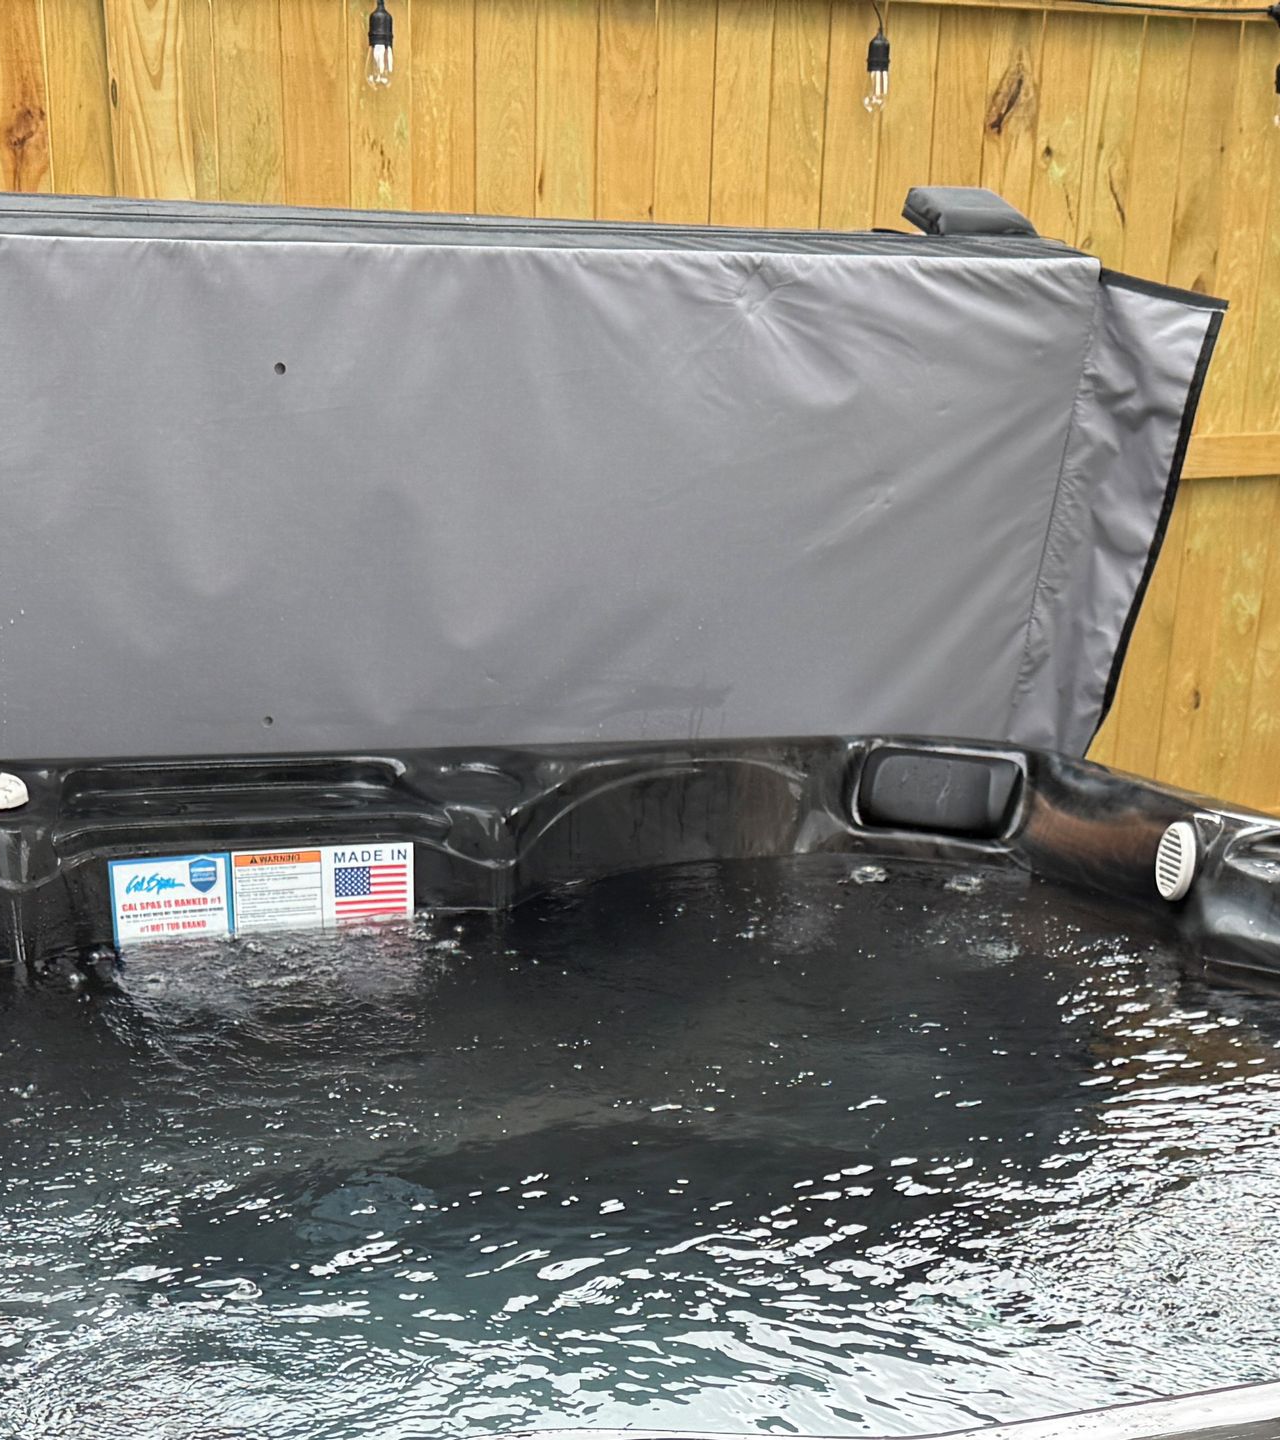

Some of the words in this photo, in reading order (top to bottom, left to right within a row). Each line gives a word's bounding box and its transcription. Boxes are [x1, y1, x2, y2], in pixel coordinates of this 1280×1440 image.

[259, 854, 300, 863] WARNING
[334, 850, 383, 863] MADE
[391, 849, 407, 861] IN
